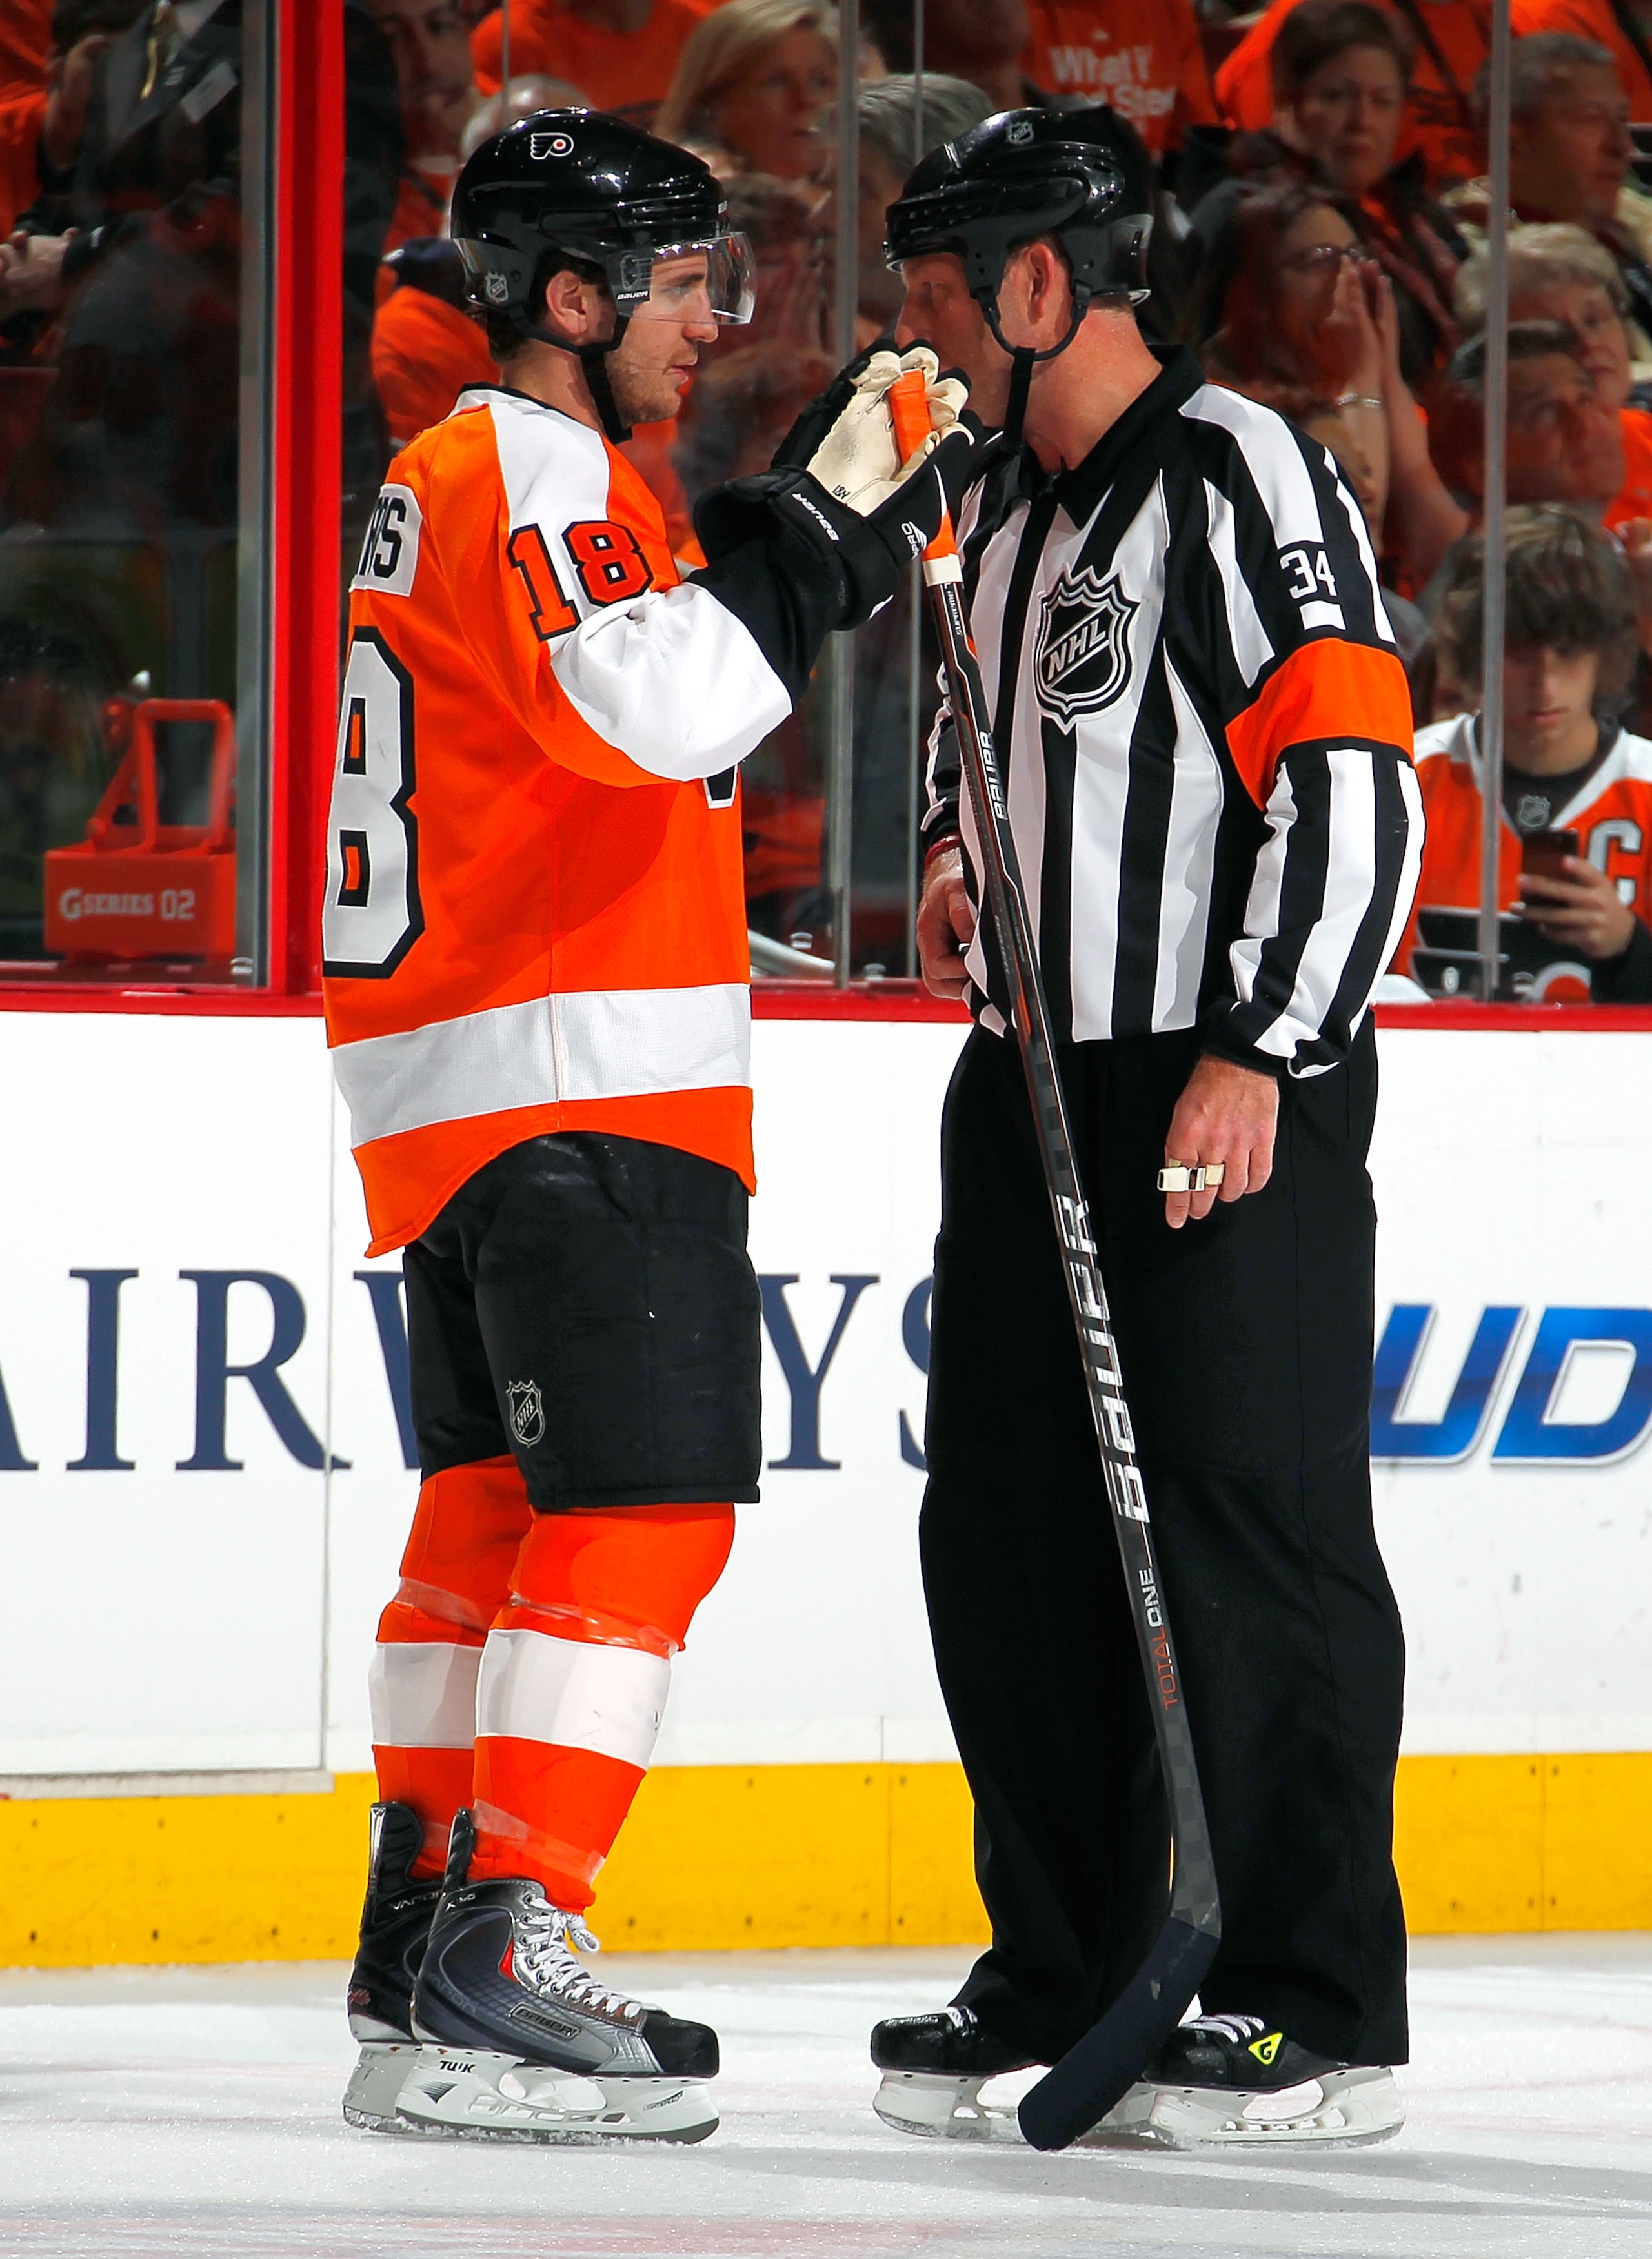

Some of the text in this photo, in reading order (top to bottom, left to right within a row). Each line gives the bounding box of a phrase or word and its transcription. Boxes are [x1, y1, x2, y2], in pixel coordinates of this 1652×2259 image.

[616, 290, 649, 302] BAUER
[791, 492, 840, 541] BAUER
[505, 519, 655, 642] 18
[1279, 549, 1337, 599] 34
[1047, 617, 1107, 682] NHL
[978, 730, 1009, 821] BAUER
[159, 889, 196, 921] 02
[1055, 1194, 1151, 1523] BAUER
[518, 2007, 575, 2036] BAUER
